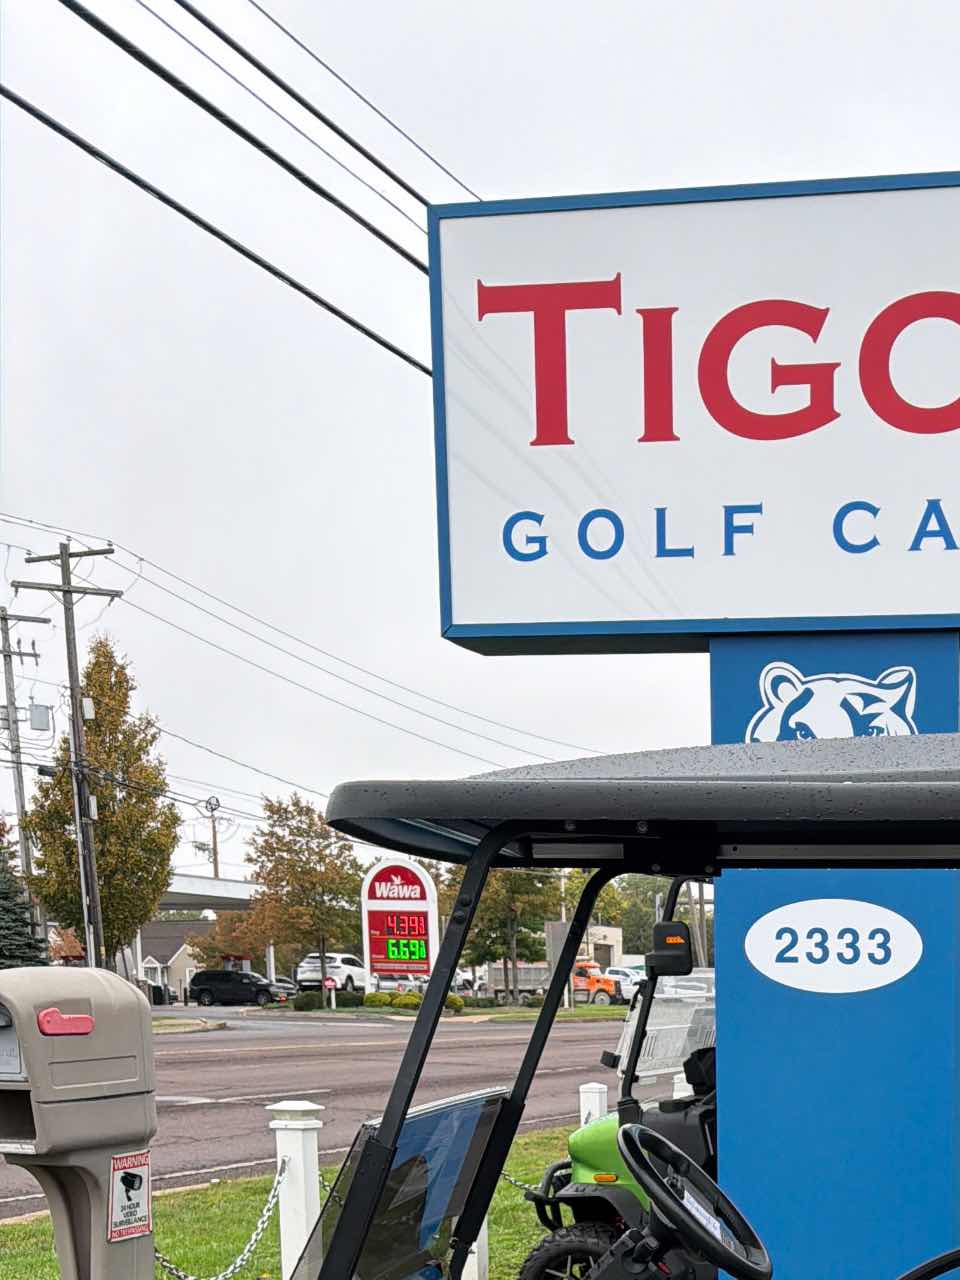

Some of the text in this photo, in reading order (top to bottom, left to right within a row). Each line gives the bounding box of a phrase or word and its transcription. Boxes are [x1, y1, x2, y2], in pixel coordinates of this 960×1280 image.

[502, 501, 763, 562] GOLF
[375, 882, 420, 898] Wawa
[773, 926, 893, 965] 2333
[114, 1155, 149, 1170] WARNING
